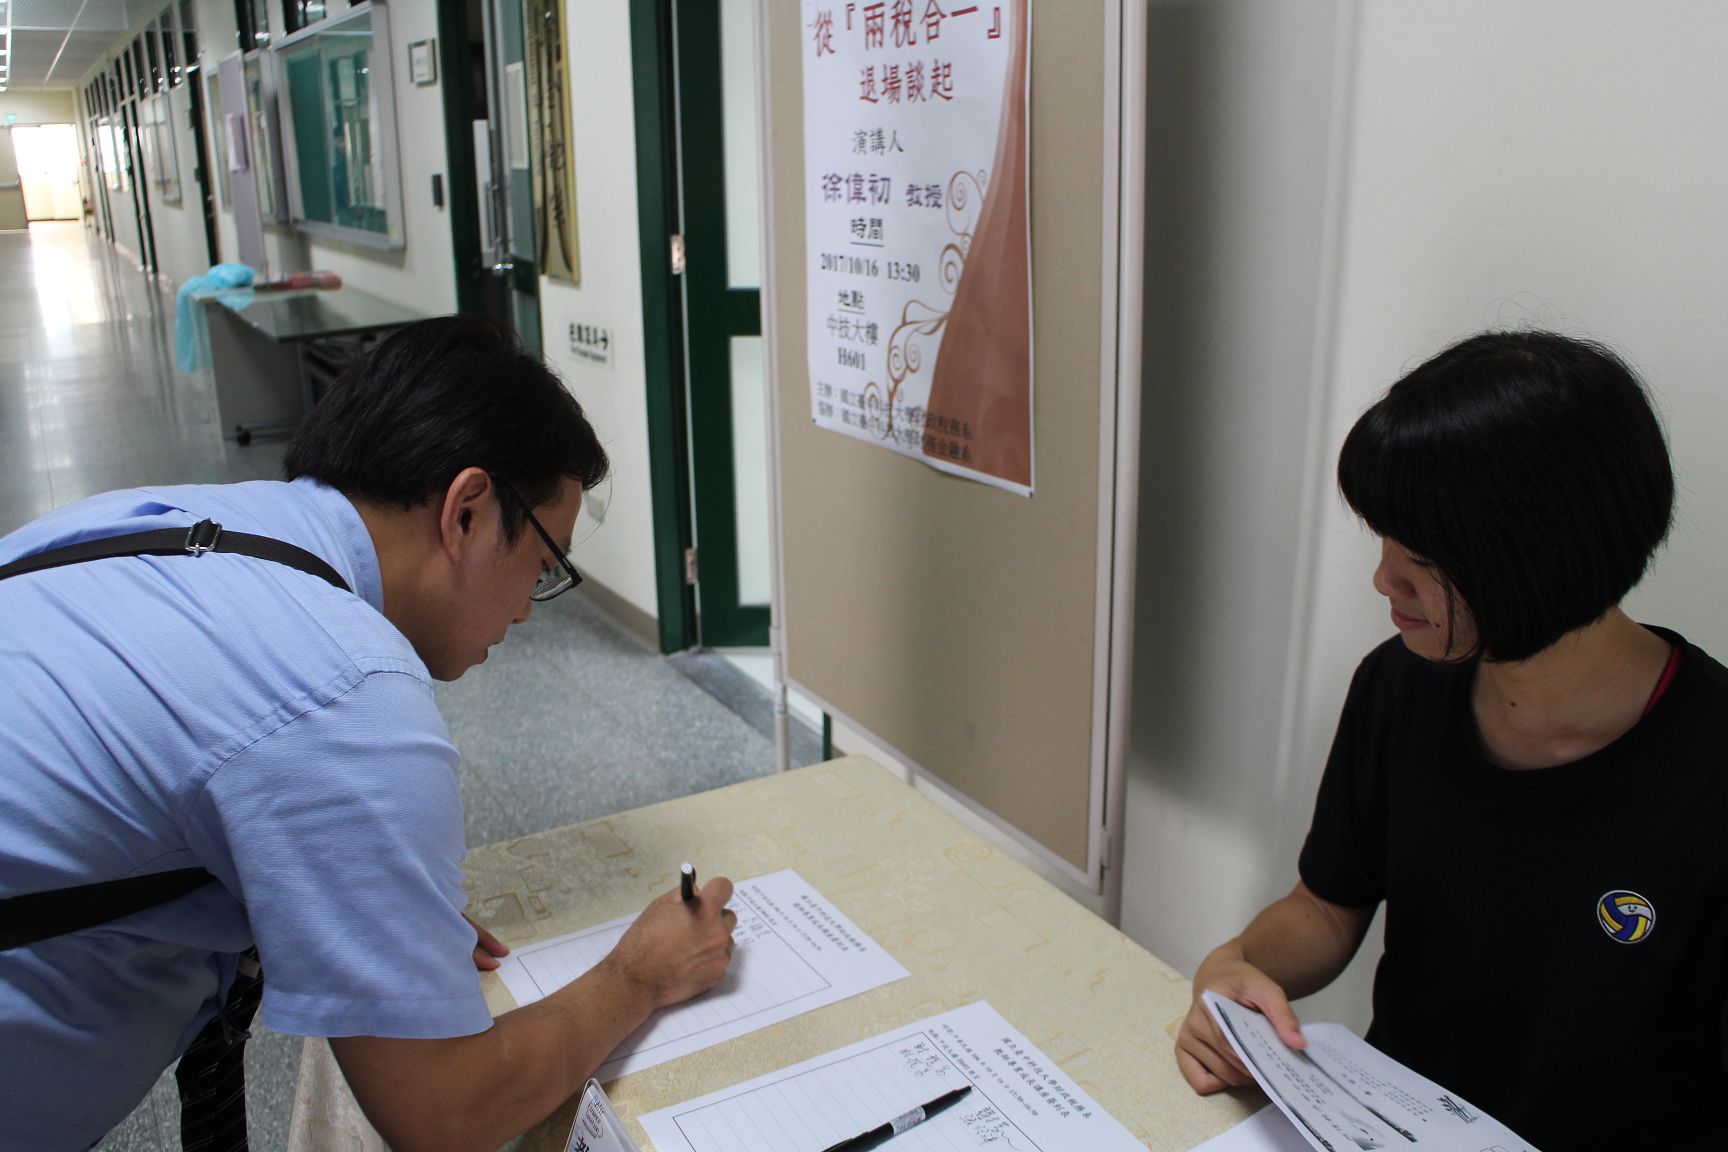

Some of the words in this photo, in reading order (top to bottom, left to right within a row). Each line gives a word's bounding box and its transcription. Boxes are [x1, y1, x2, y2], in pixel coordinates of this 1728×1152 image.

[858, 58, 955, 105] 退場談起
[852, 127, 904, 156] 演講人
[821, 172, 892, 207] 徐偉初
[905, 183, 944, 210] 教授
[850, 217, 883, 241] 時間
[820, 253, 879, 278] 2017/10/16
[887, 261, 921, 284] 13:30
[837, 289, 865, 310] 地點
[827, 314, 879, 347] 中技大樓
[837, 347, 867, 371] H601
